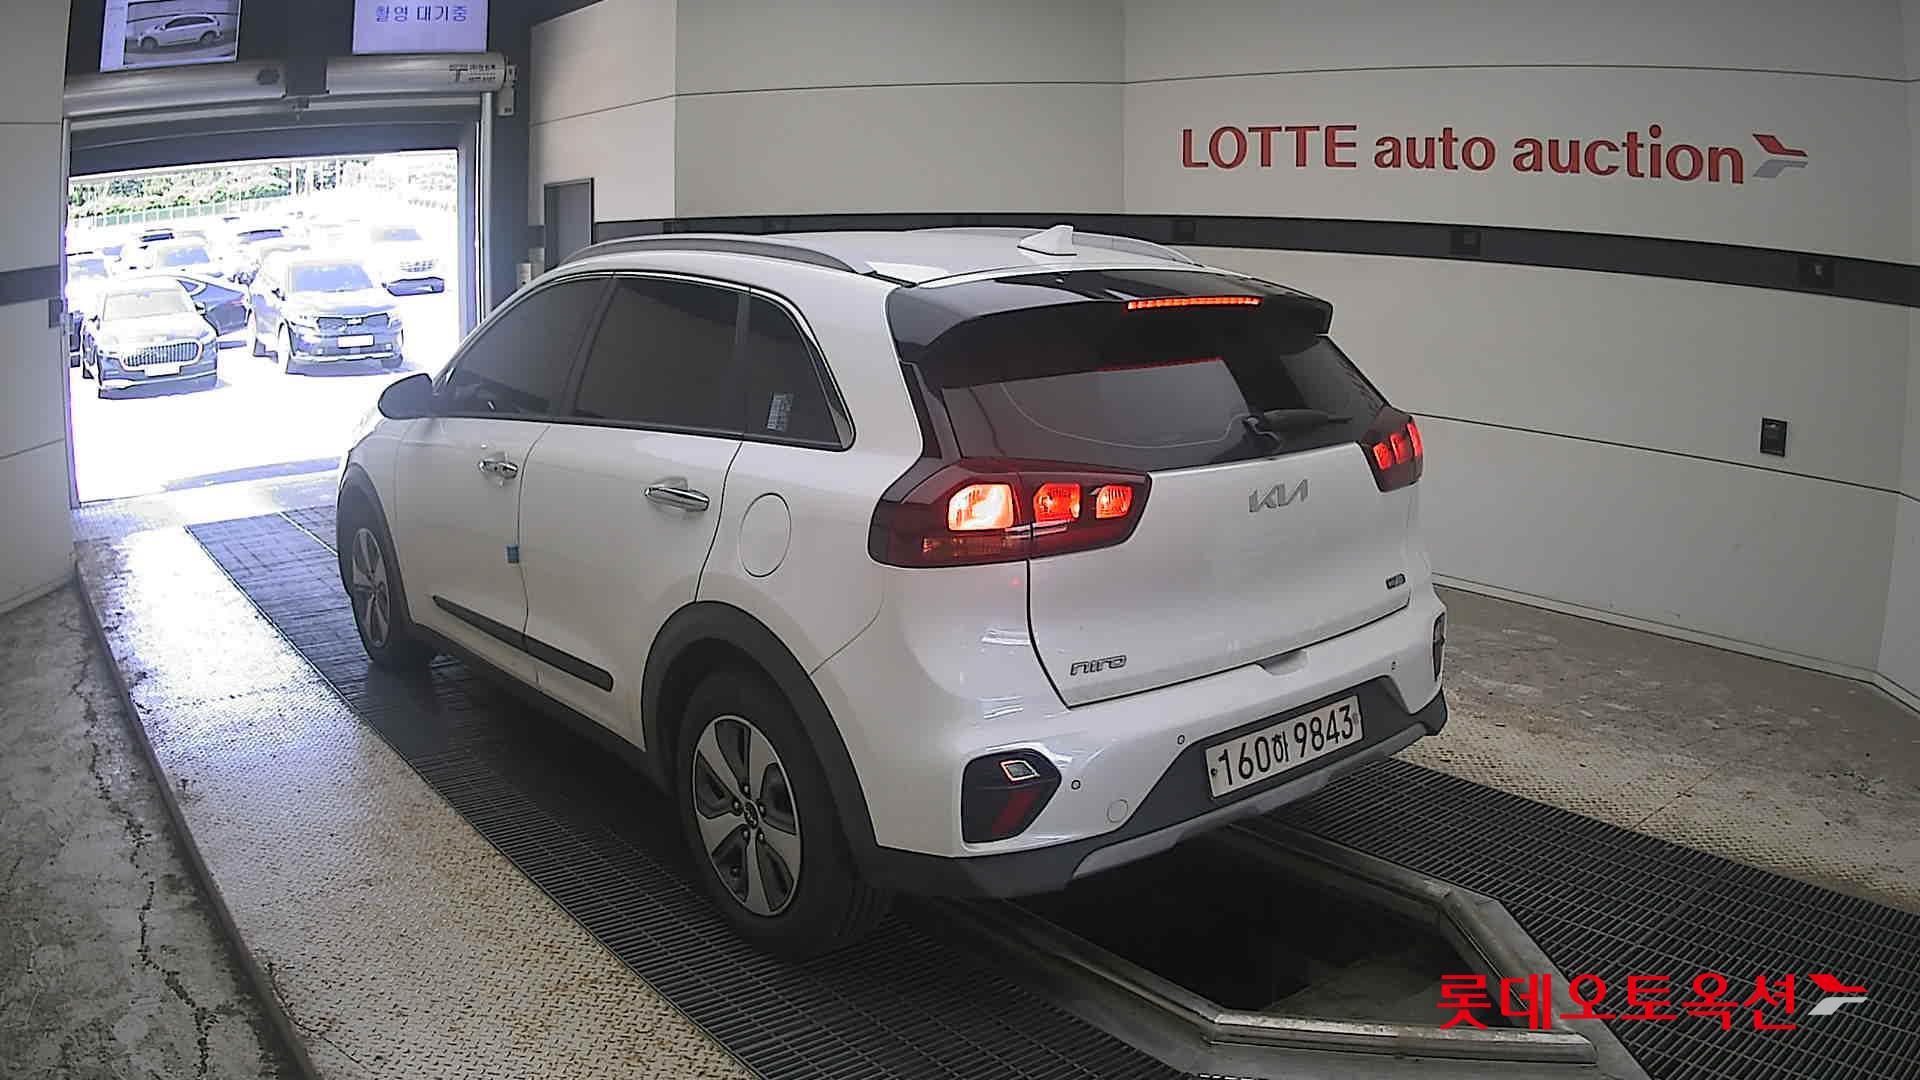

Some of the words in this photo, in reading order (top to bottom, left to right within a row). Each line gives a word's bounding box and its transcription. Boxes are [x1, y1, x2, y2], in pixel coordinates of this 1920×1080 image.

[417, 5, 466, 22] 대기중
[1181, 124, 1358, 169] LOTTE
[1373, 126, 1497, 172] auto
[1512, 123, 1744, 184] auction
[1248, 479, 1309, 513] KIA
[1218, 731, 1289, 786] 160하
[1293, 704, 1354, 758] 9843
